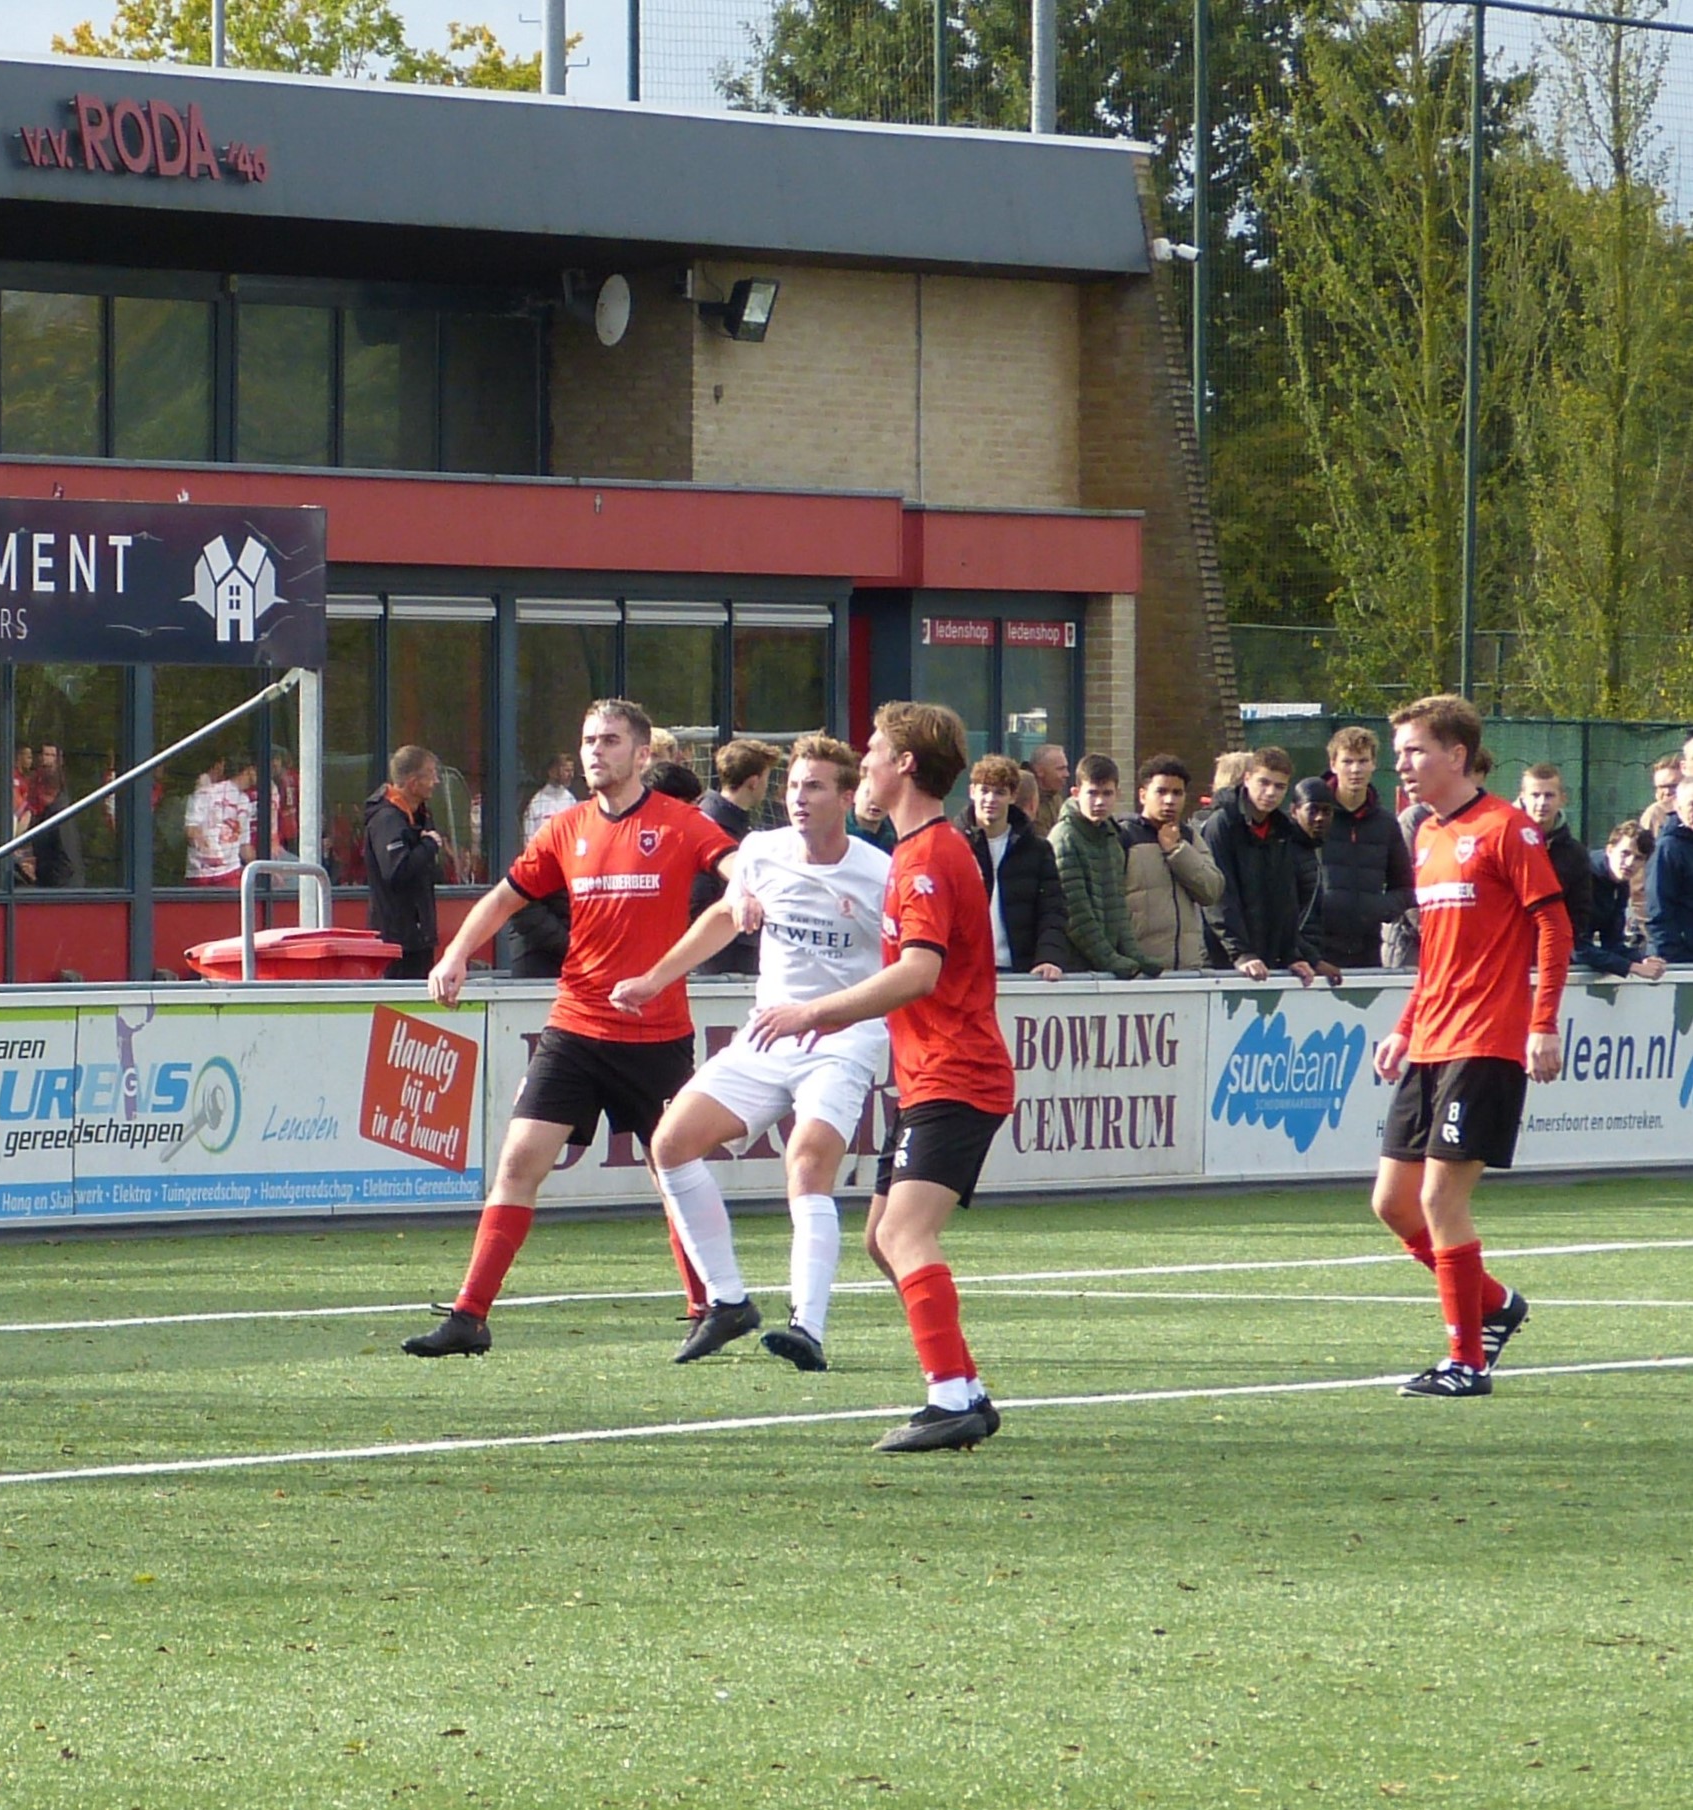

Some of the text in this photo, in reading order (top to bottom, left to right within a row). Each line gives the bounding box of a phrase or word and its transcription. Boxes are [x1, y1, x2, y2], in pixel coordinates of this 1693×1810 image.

[75, 93, 221, 180] RODA
[935, 620, 989, 644] ledenshop
[1008, 621, 1060, 645] ledenshop
[387, 1019, 459, 1094] Handig
[1013, 1012, 1177, 1072] BOWLING
[1561, 1018, 1677, 1081] lean.nl
[401, 1074, 423, 1117] bij
[1227, 1041, 1350, 1110] succlean!
[371, 1105, 459, 1160] in de buurt!
[1012, 1094, 1176, 1155] CENTRUM
[1448, 1101, 1460, 1122] 8
[1527, 1113, 1590, 1132] Amersfoort
[1590, 1115, 1604, 1130] en
[4, 1118, 184, 1157] gereedschappen
[112, 1184, 151, 1203] Elektra
[162, 1181, 251, 1207] Tuingereedschap
[260, 1178, 353, 1204] Handgereedschap
[363, 1177, 413, 1197] Elektrisch
[414, 1176, 479, 1199] Gereedschap
